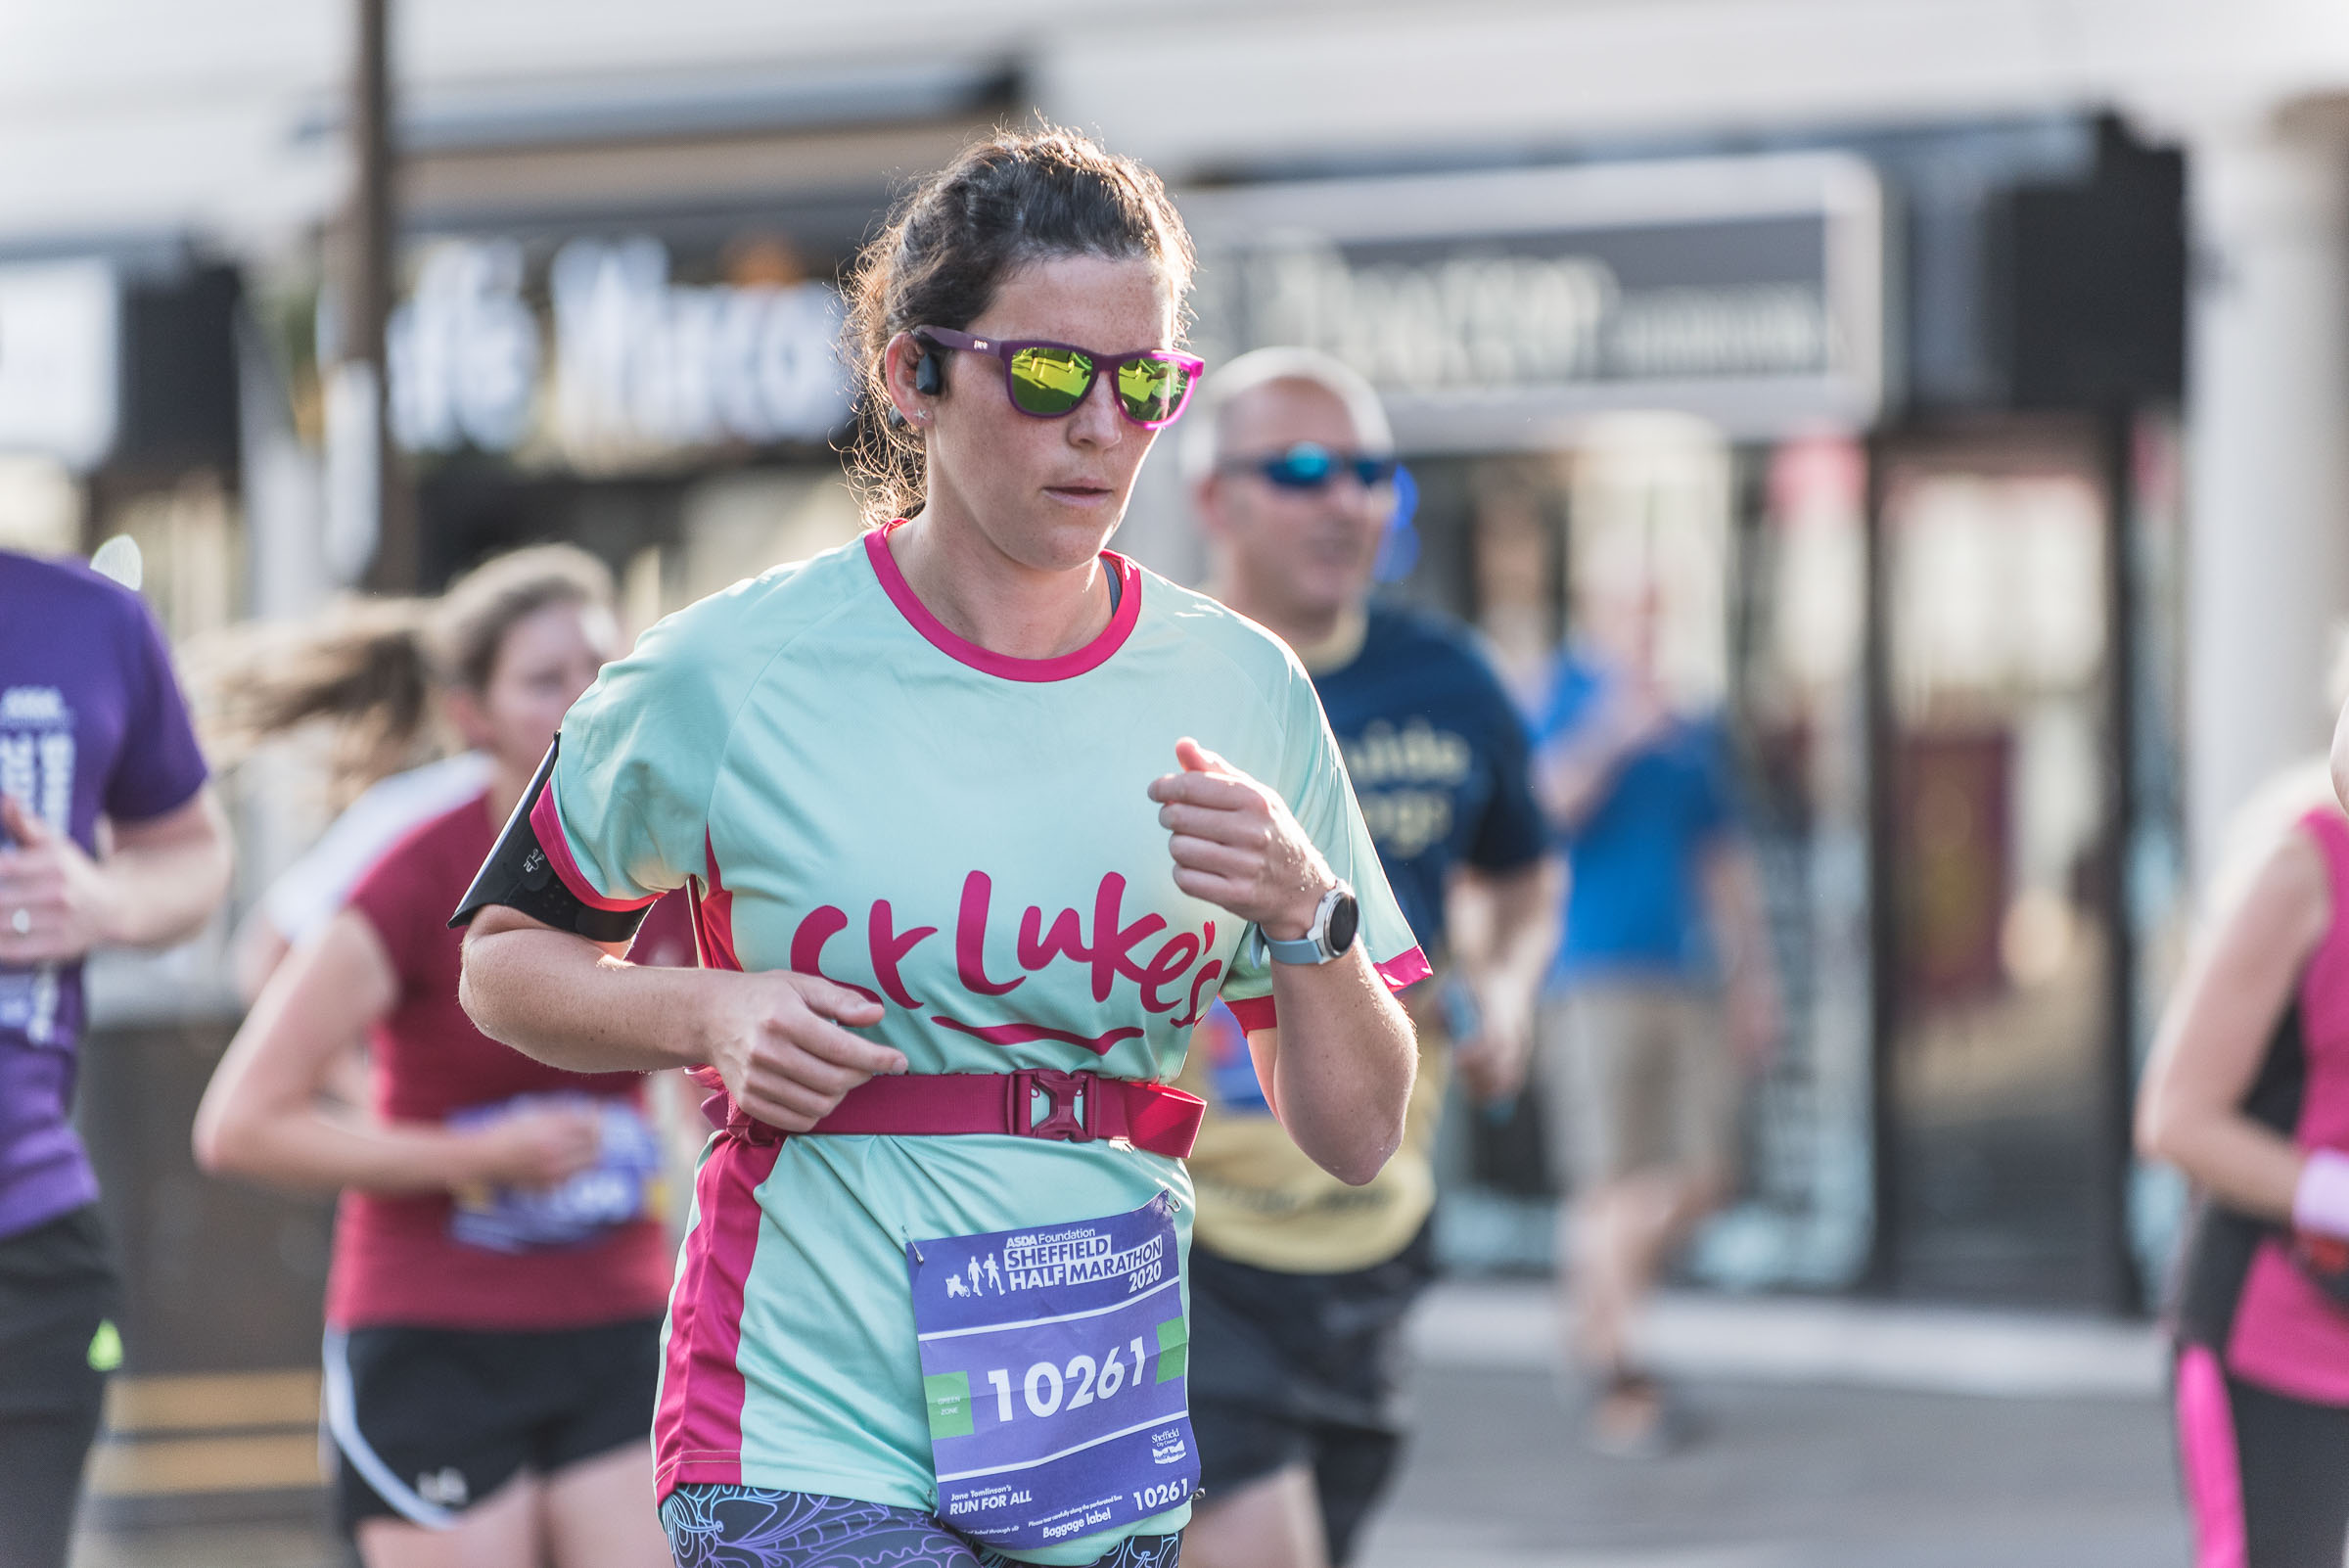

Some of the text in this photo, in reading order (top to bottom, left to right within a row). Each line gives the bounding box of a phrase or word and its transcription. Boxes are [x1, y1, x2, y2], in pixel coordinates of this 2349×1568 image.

[790, 869, 1222, 1029] St Luke's
[1006, 1227, 1096, 1248] ASDA Foundation
[1006, 1238, 1110, 1269] SHEFFIELD
[1009, 1237, 1163, 1292] HALF MARATHON
[1128, 1262, 1162, 1294] 2020
[987, 1335, 1146, 1423] 10261
[1151, 1427, 1180, 1444] Sheffield
[949, 1490, 1033, 1516] RUN FOR ALL
[951, 1484, 1012, 1501] Jane Tomlinson's
[1042, 1478, 1188, 1539] Baggage label 10261
